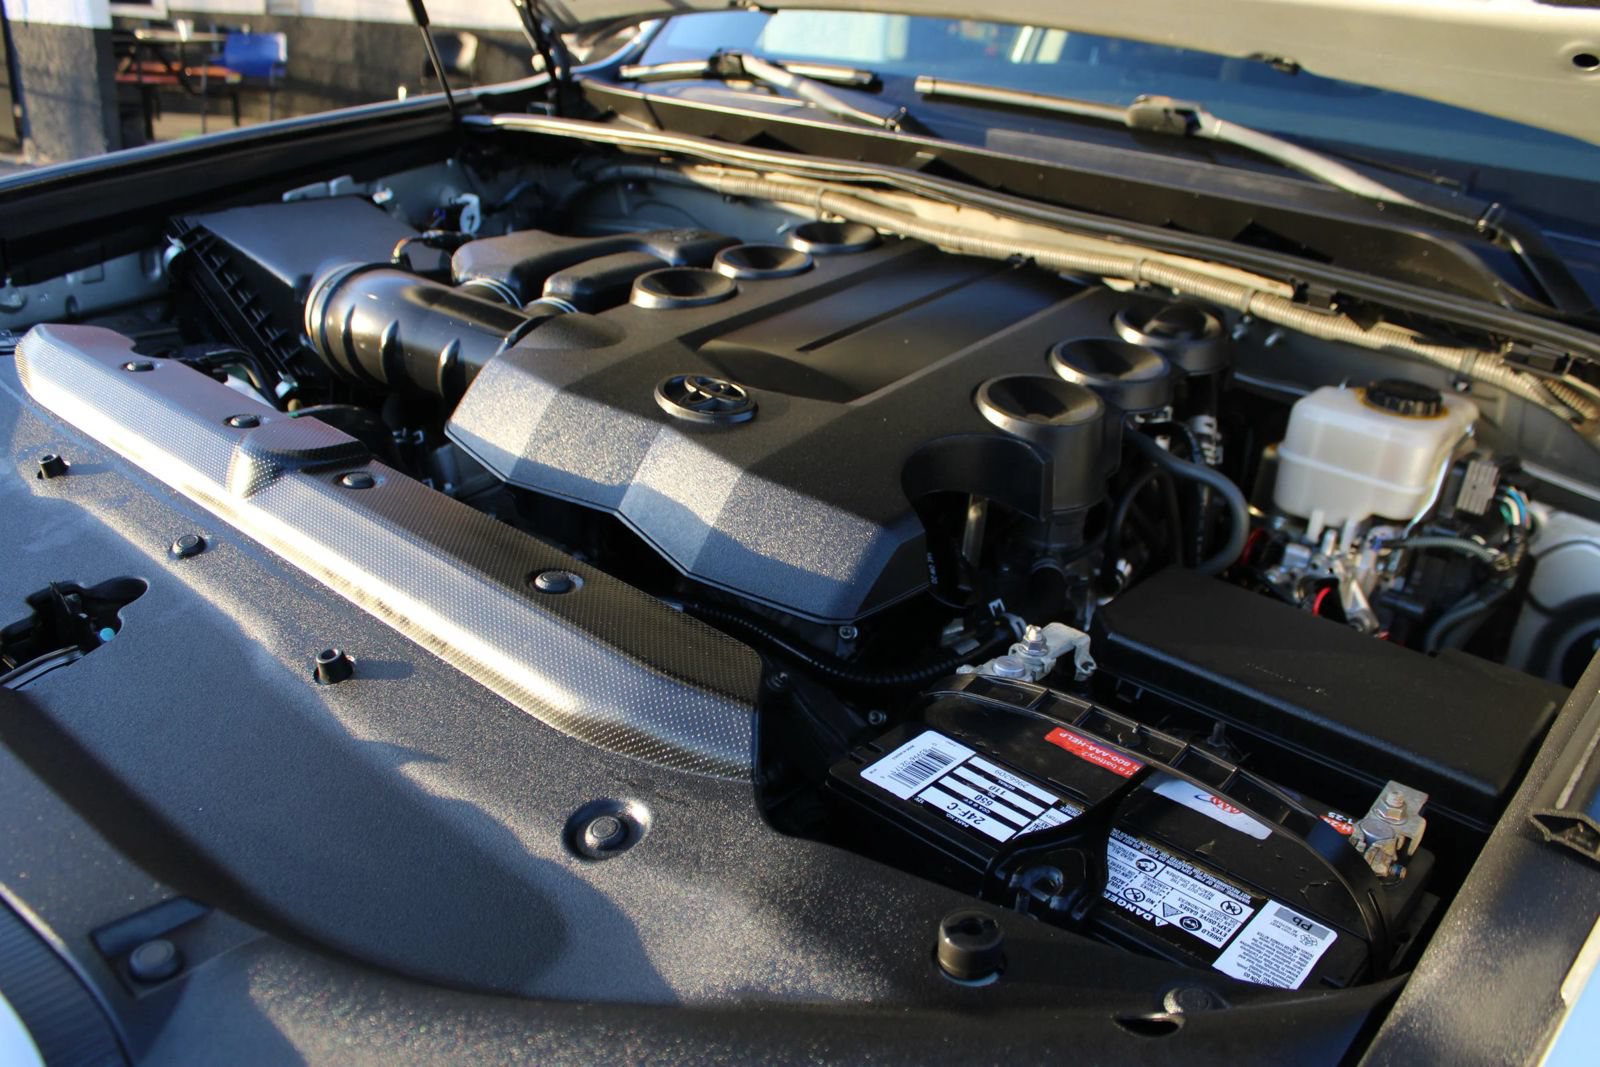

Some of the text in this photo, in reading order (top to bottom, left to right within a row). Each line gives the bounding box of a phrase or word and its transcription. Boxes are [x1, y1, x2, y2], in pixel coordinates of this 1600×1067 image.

[1060, 733, 1130, 766] 800-AAA-HELP
[1081, 751, 1117, 769] battery?
[988, 786, 1006, 795] 110
[998, 780, 1015, 790] SERIAL
[974, 795, 993, 806] 650
[947, 803, 985, 824] 24F-C
[955, 819, 969, 827] PART
[1111, 876, 1125, 884] ACID
[1166, 870, 1190, 885] CHILDREN
[1198, 887, 1214, 897] REACH
[1105, 893, 1153, 920] DANGER
[1178, 897, 1206, 913] BLINDNESS
[1179, 904, 1231, 932] EXPLOSIVE GASES
[1207, 912, 1223, 922] CAUSE
[1211, 908, 1229, 920] INJURY
[1293, 917, 1313, 931] Pb
[1201, 929, 1223, 942] SHIELD
[1211, 927, 1227, 937] EYES.
